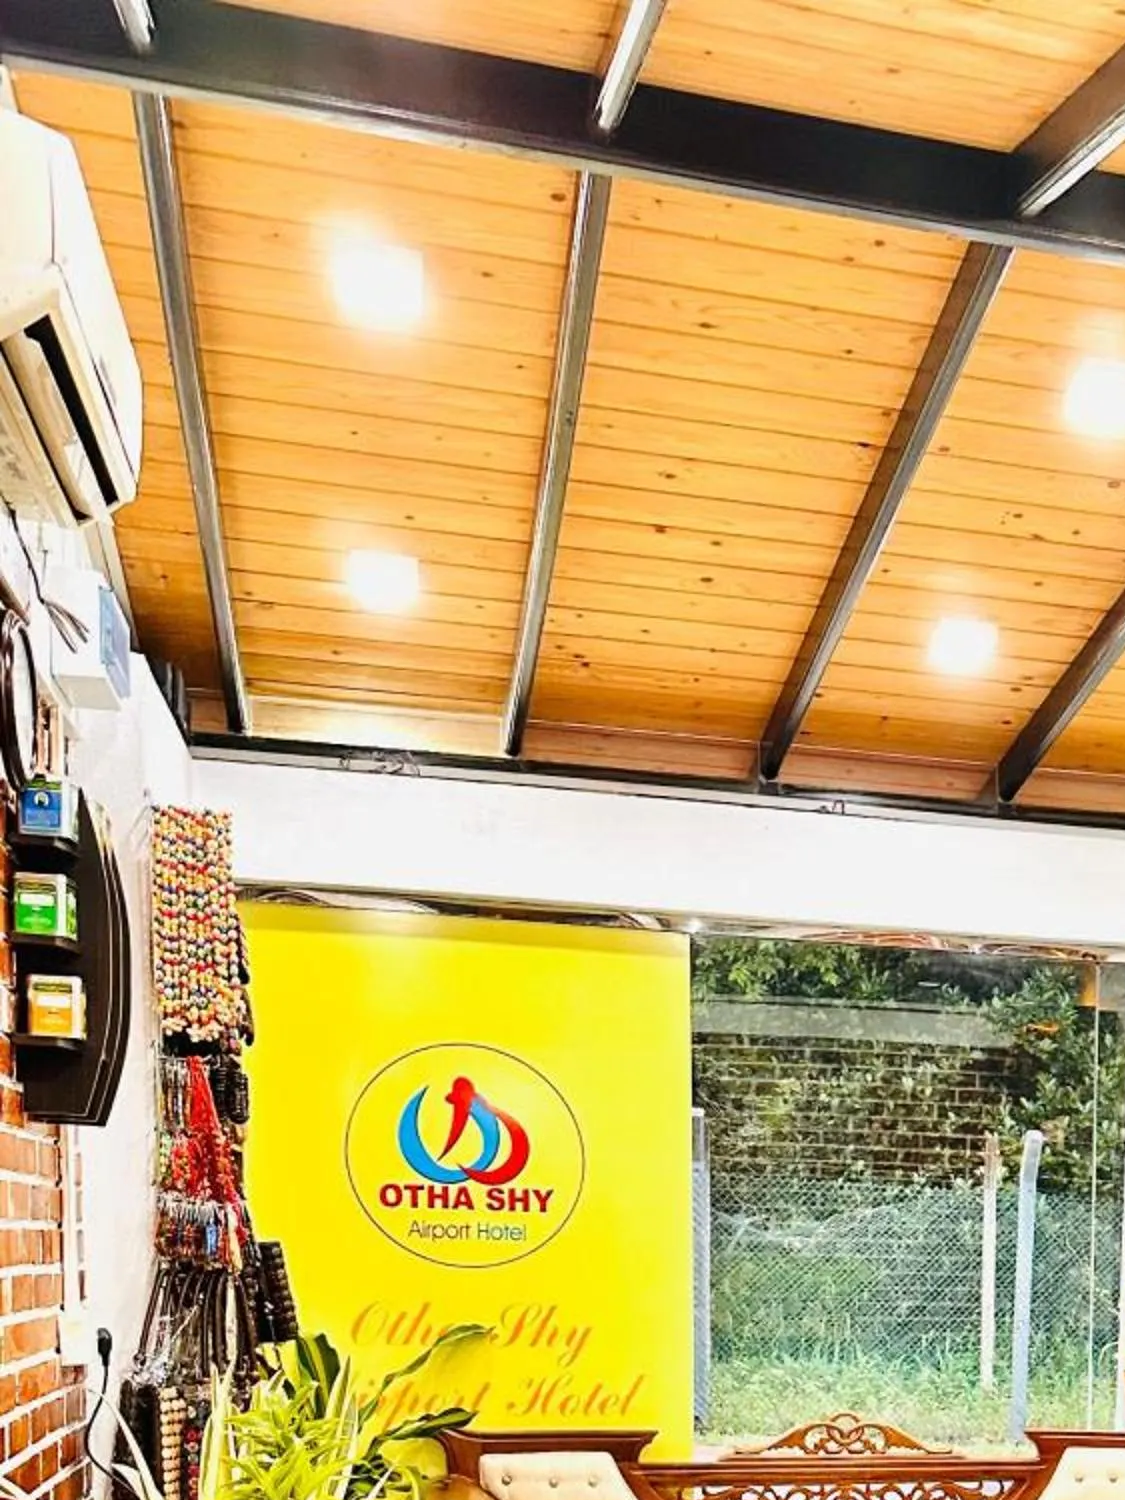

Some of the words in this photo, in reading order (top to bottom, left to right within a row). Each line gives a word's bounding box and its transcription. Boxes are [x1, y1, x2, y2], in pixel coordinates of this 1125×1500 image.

[379, 1183, 475, 1211] OTHA
[486, 1187, 554, 1213] SHY
[408, 1219, 472, 1242] Airport
[477, 1221, 527, 1242] Hotel
[489, 1301, 594, 1369] Shy
[506, 1371, 646, 1413] Hotel
